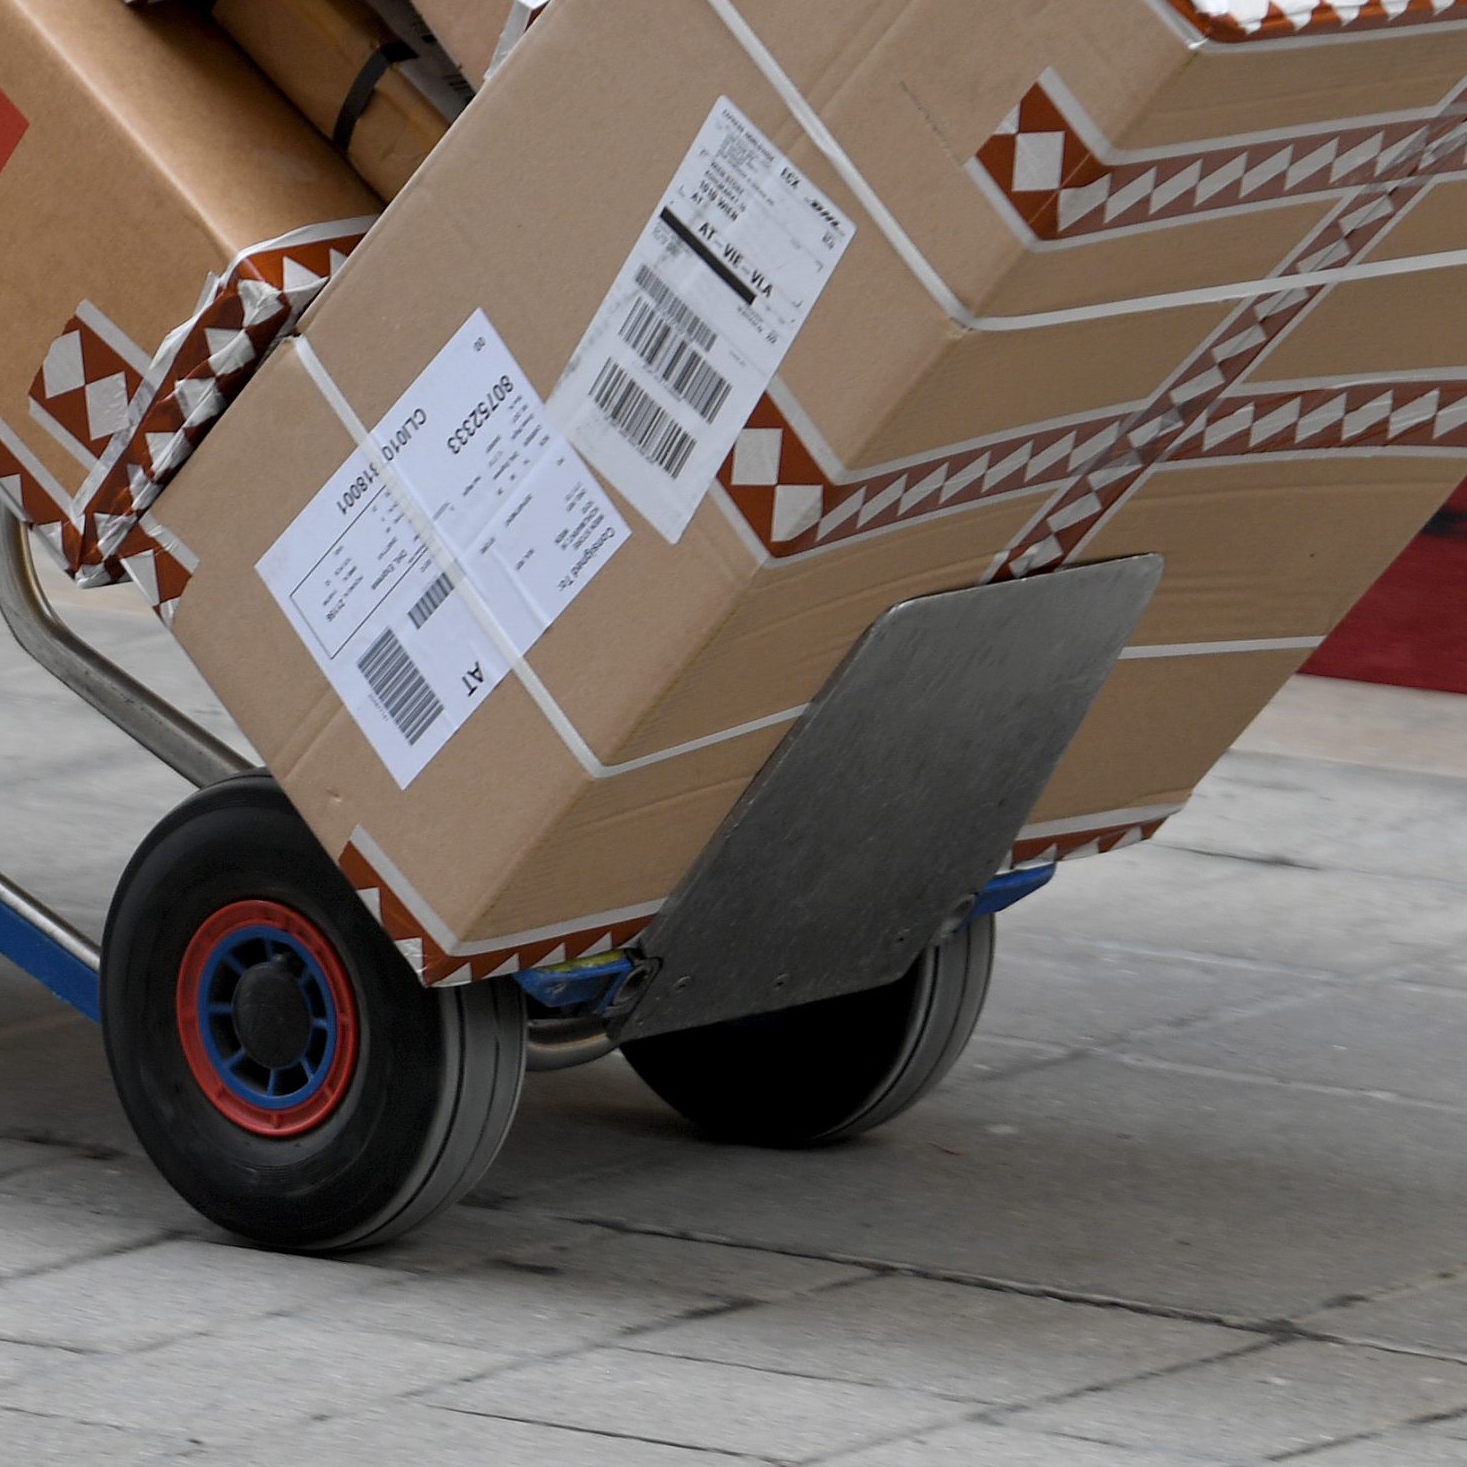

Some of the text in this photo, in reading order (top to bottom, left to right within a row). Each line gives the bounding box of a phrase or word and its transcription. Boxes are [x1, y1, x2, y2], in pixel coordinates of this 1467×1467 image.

[447, 375, 513, 454] 80752333
[570, 526, 615, 577] Consigned
[461, 661, 483, 696] AT
